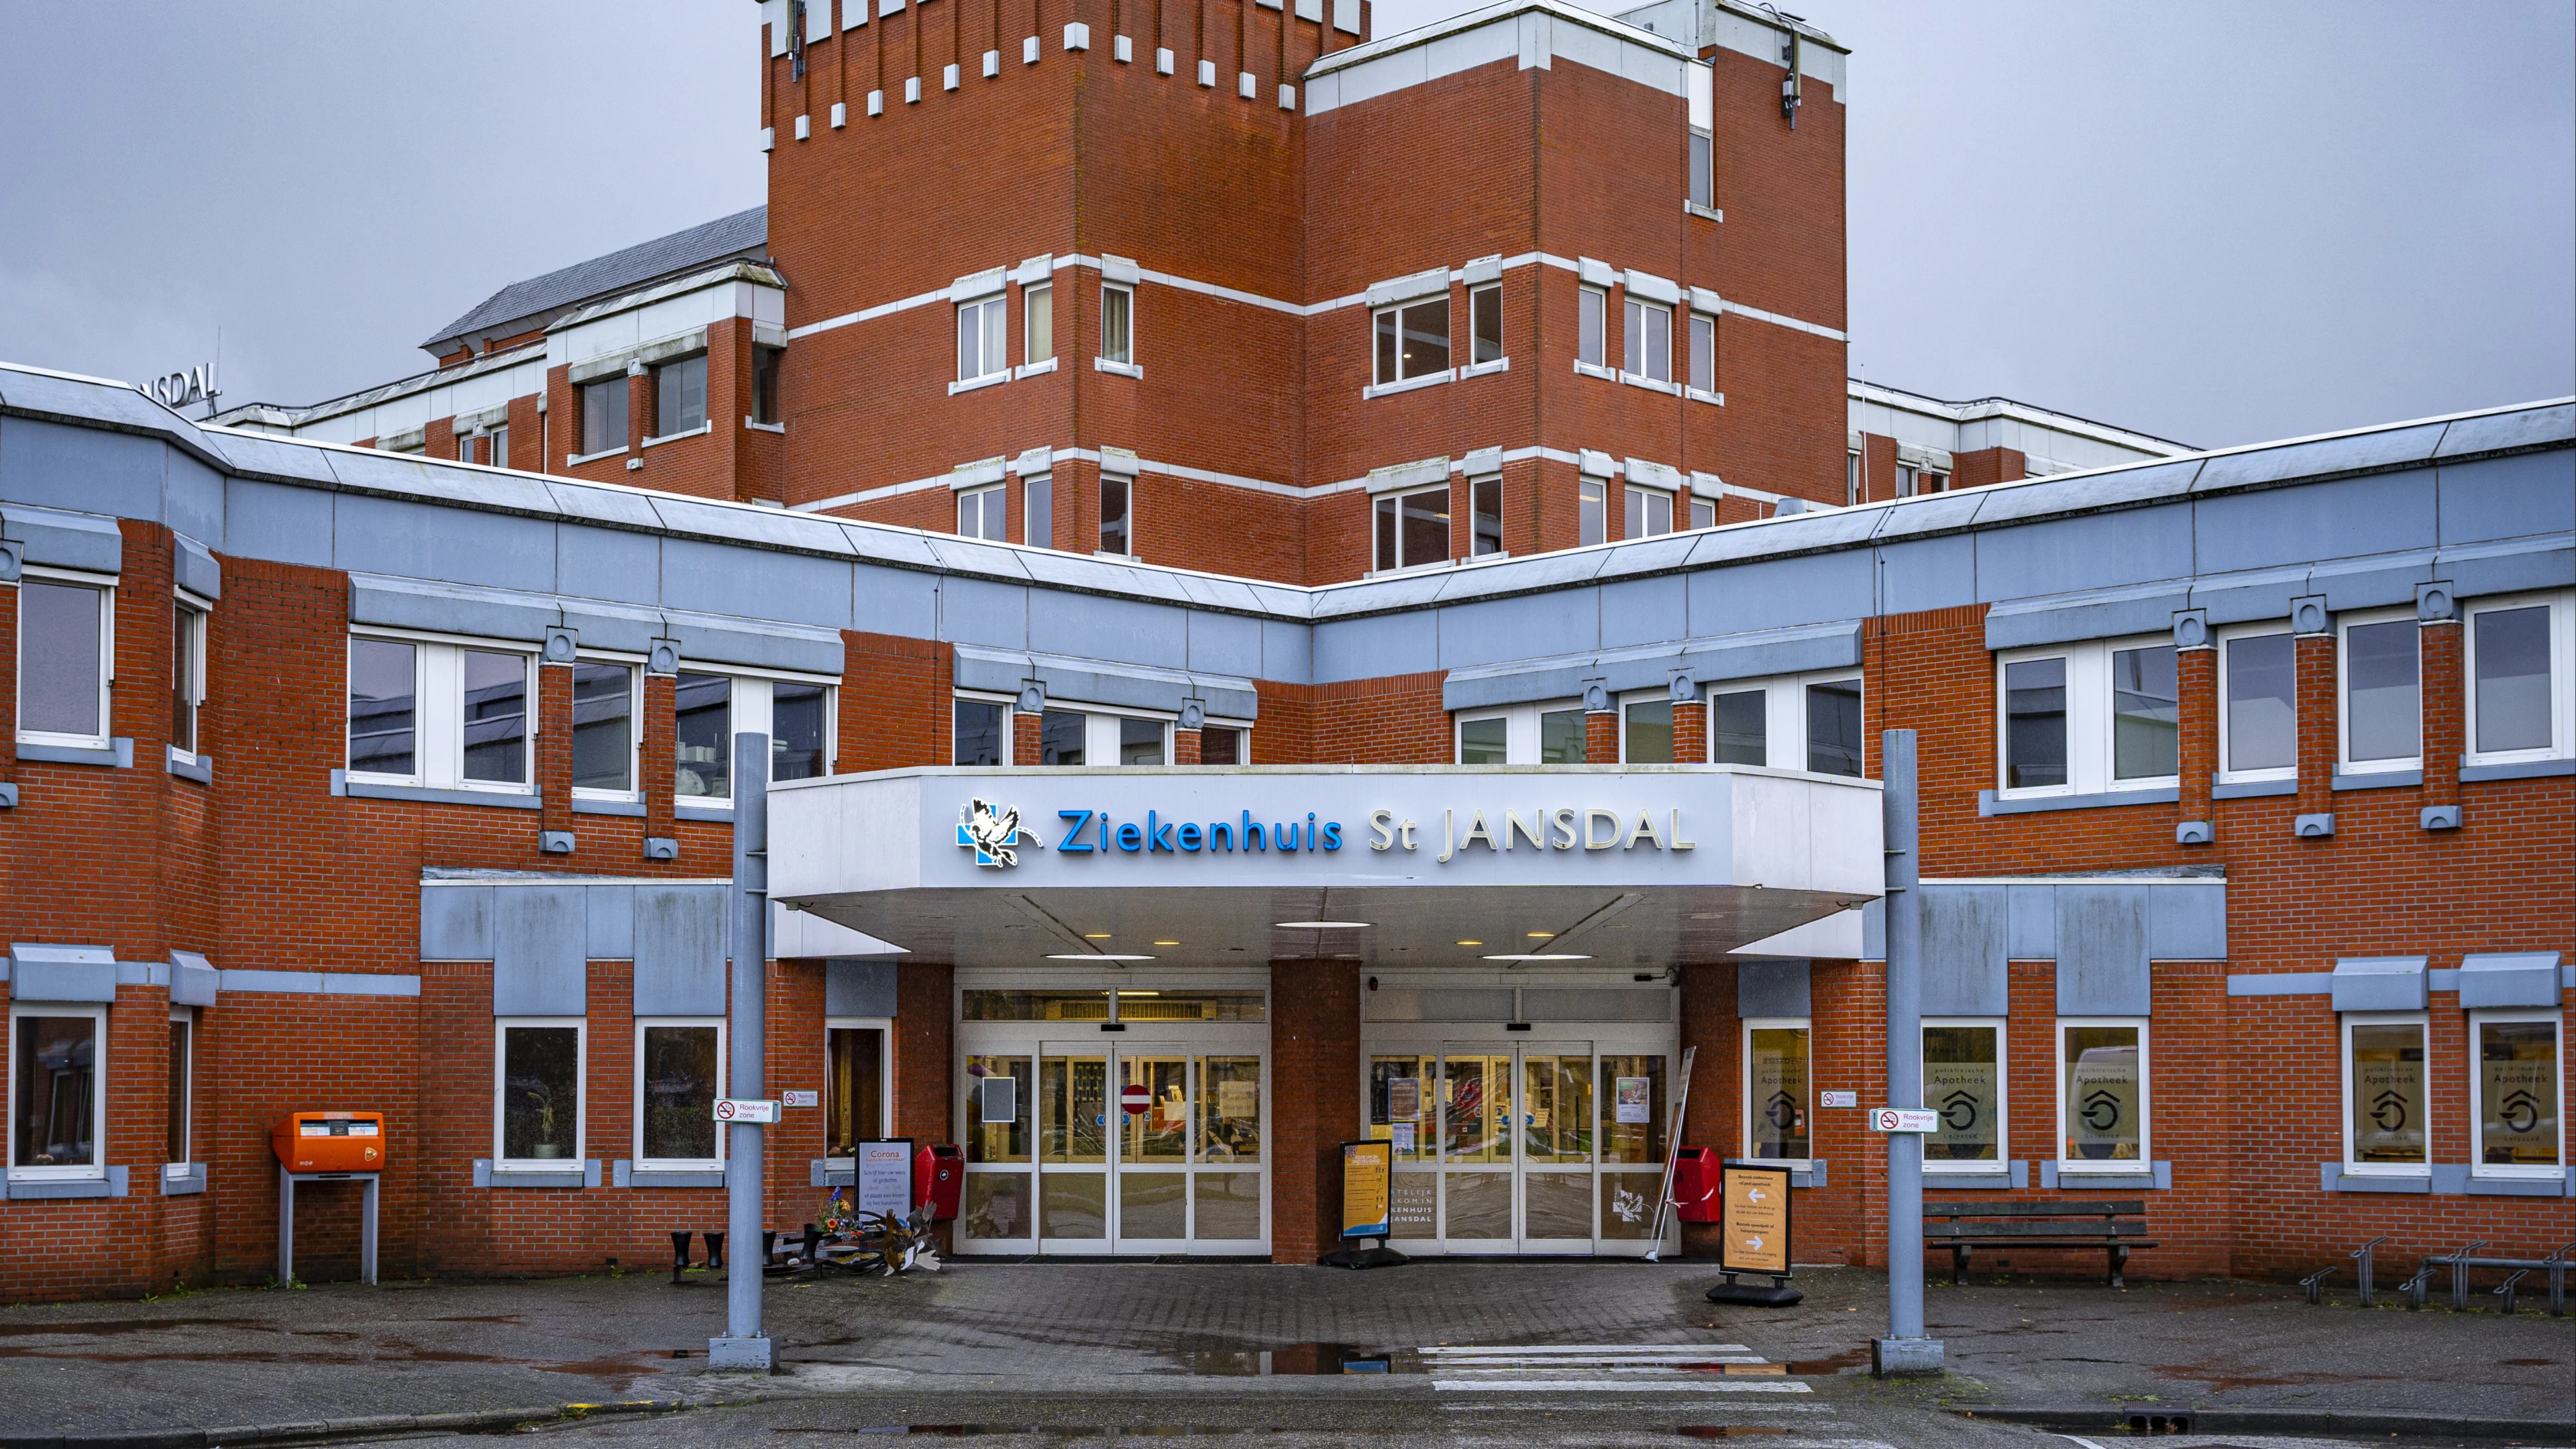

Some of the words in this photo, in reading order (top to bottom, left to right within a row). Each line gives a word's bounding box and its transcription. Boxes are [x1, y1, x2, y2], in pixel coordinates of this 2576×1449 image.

[1057, 810, 1342, 852] Ziekenhuis
[1370, 808, 1419, 850] St
[1438, 808, 1697, 862] JANSDAL
[1761, 1076, 1802, 1085] Apotheek
[1934, 1076, 1986, 1085] Apotheek
[2076, 1076, 2128, 1085] Apotheek
[2365, 1075, 2415, 1086] Apotheek
[2494, 1074, 2548, 1085] Apotheek
[739, 1104, 769, 1112] Rookvrije
[1903, 1114, 1933, 1122] Rookvrije
[871, 1150, 900, 1158] Corona
